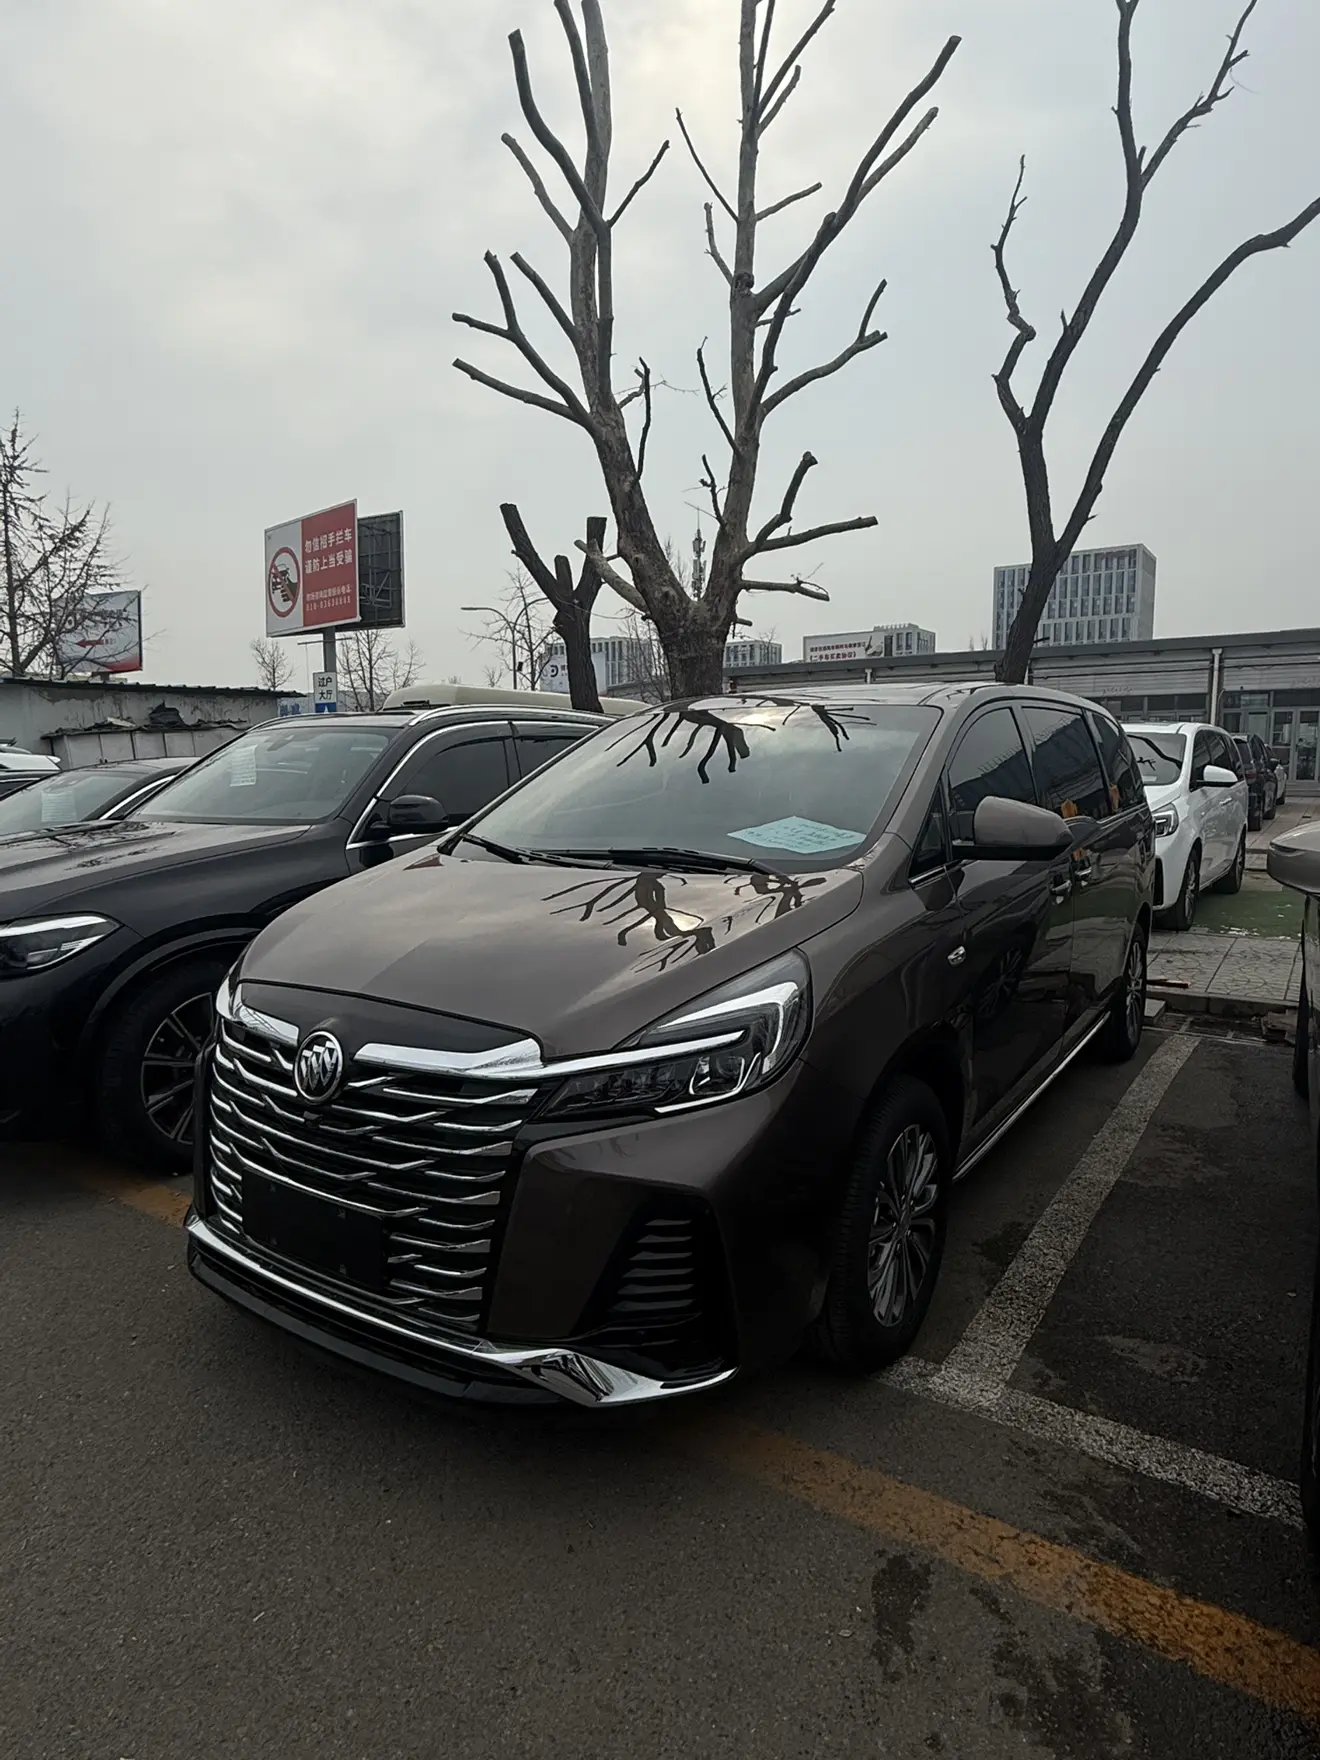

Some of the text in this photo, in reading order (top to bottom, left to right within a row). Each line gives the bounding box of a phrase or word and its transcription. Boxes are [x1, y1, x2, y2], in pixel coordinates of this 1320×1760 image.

[305, 528, 352, 553] 勿信招手拦车
[305, 549, 352, 574] 谨防上当受骗
[318, 676, 332, 687] 过户
[319, 690, 332, 700] 大厅
